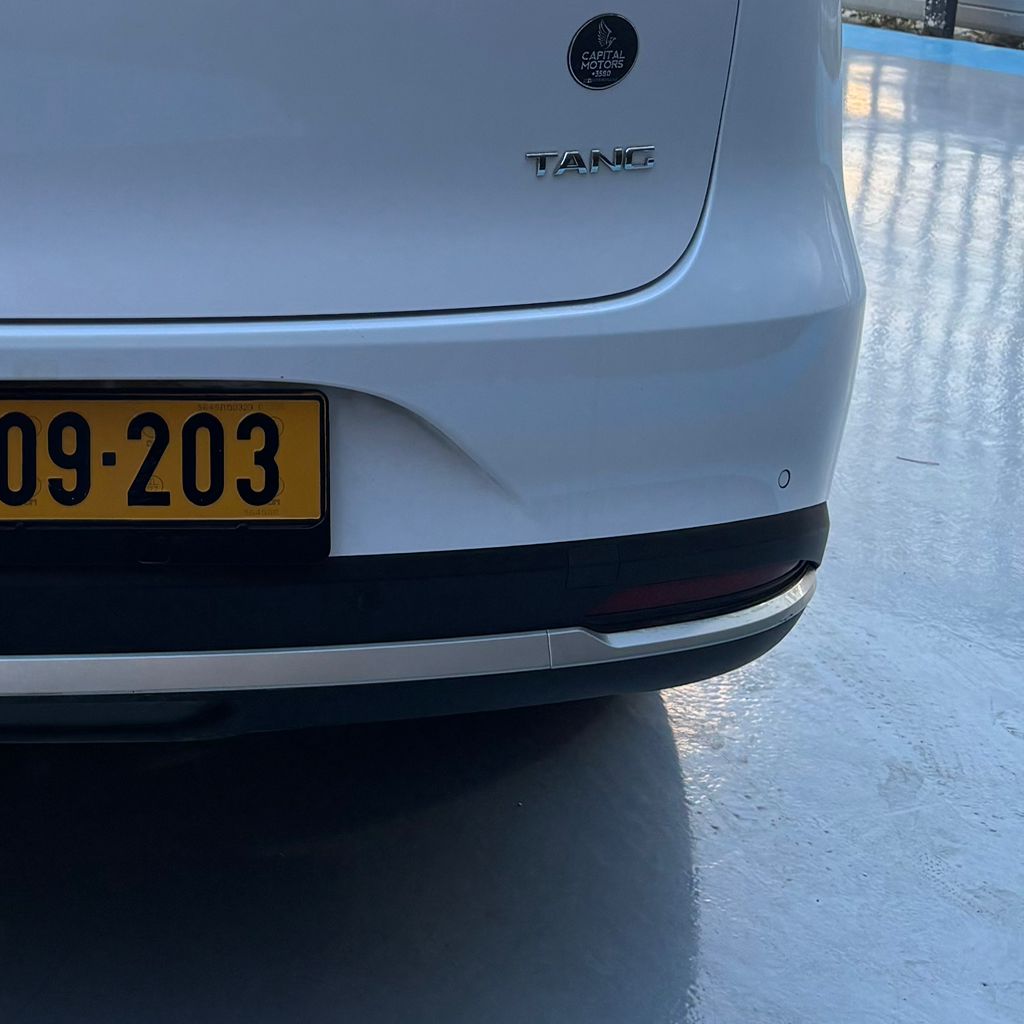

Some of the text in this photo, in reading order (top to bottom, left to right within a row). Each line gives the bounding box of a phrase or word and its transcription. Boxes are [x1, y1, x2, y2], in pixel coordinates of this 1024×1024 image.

[581, 49, 626, 61] CAPITAL
[580, 59, 625, 71] MOTORS
[525, 145, 656, 177] TANG
